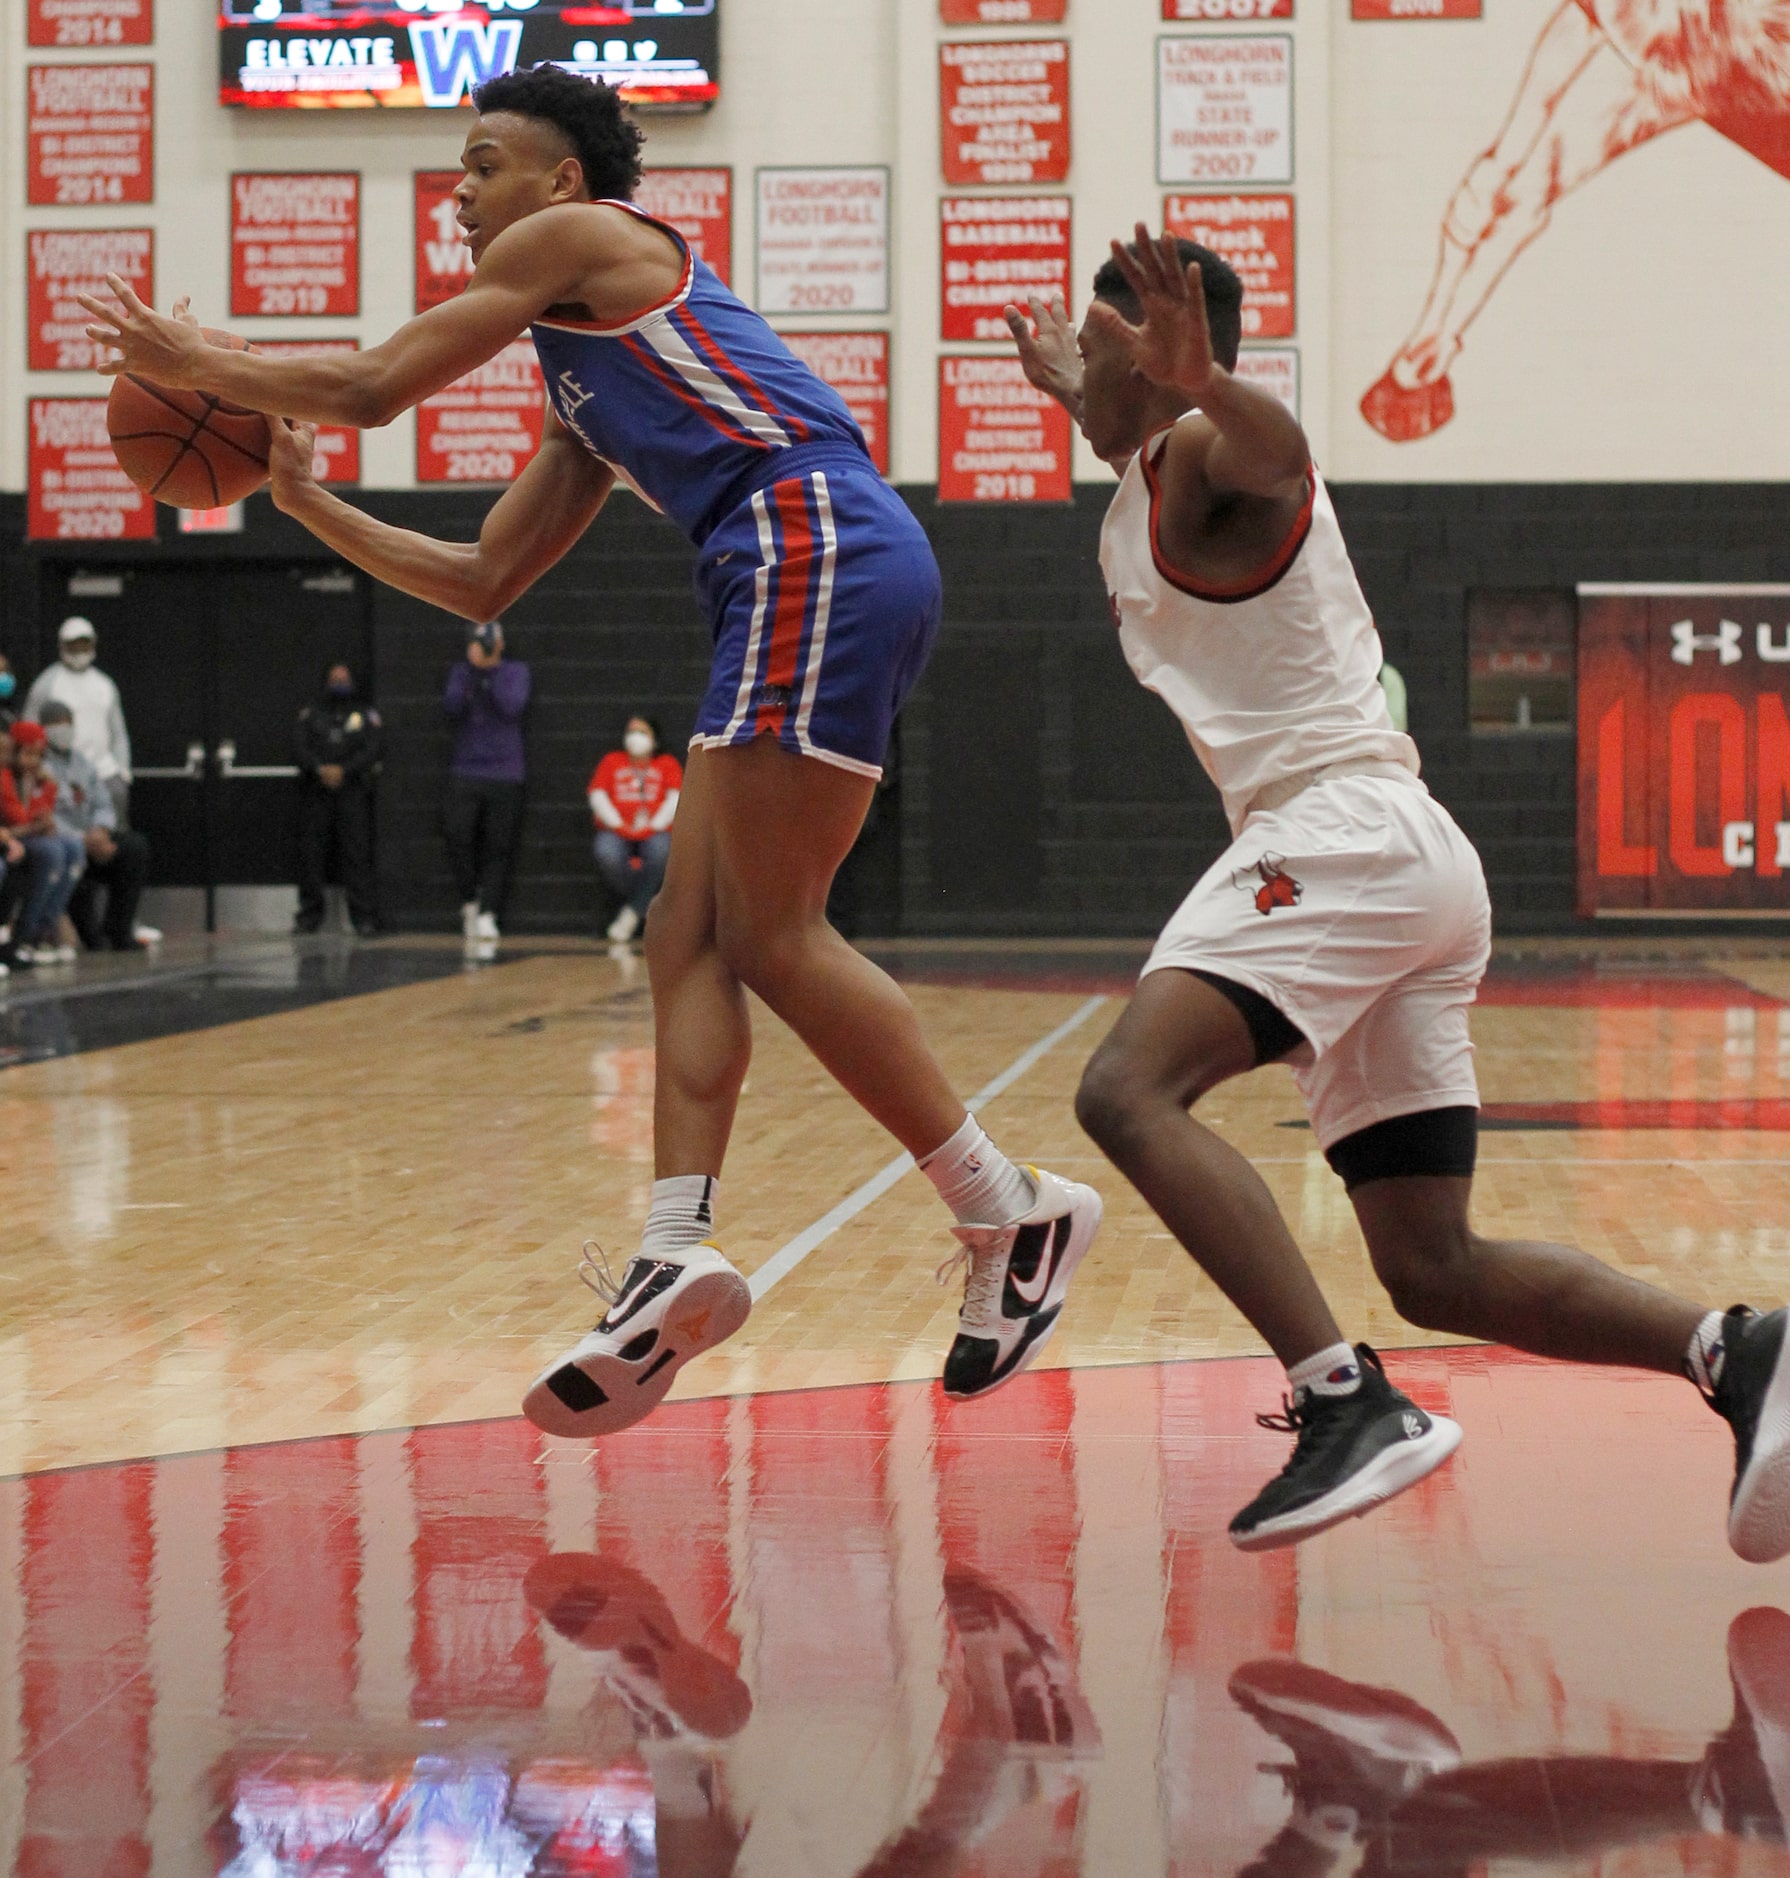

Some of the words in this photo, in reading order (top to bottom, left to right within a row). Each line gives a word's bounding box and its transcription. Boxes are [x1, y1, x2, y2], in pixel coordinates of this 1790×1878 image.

[246, 37, 394, 67] ELEVATE
[1164, 45, 1284, 64] LONGHORN
[1191, 153, 1257, 177] 2007
[763, 179, 880, 200] LONGHORN
[767, 204, 878, 225] FOOTBALL
[943, 198, 1069, 222] LONGHORN
[946, 223, 1065, 246] BASEBALL
[788, 284, 854, 306] 2020
[446, 452, 516, 480] 2020
